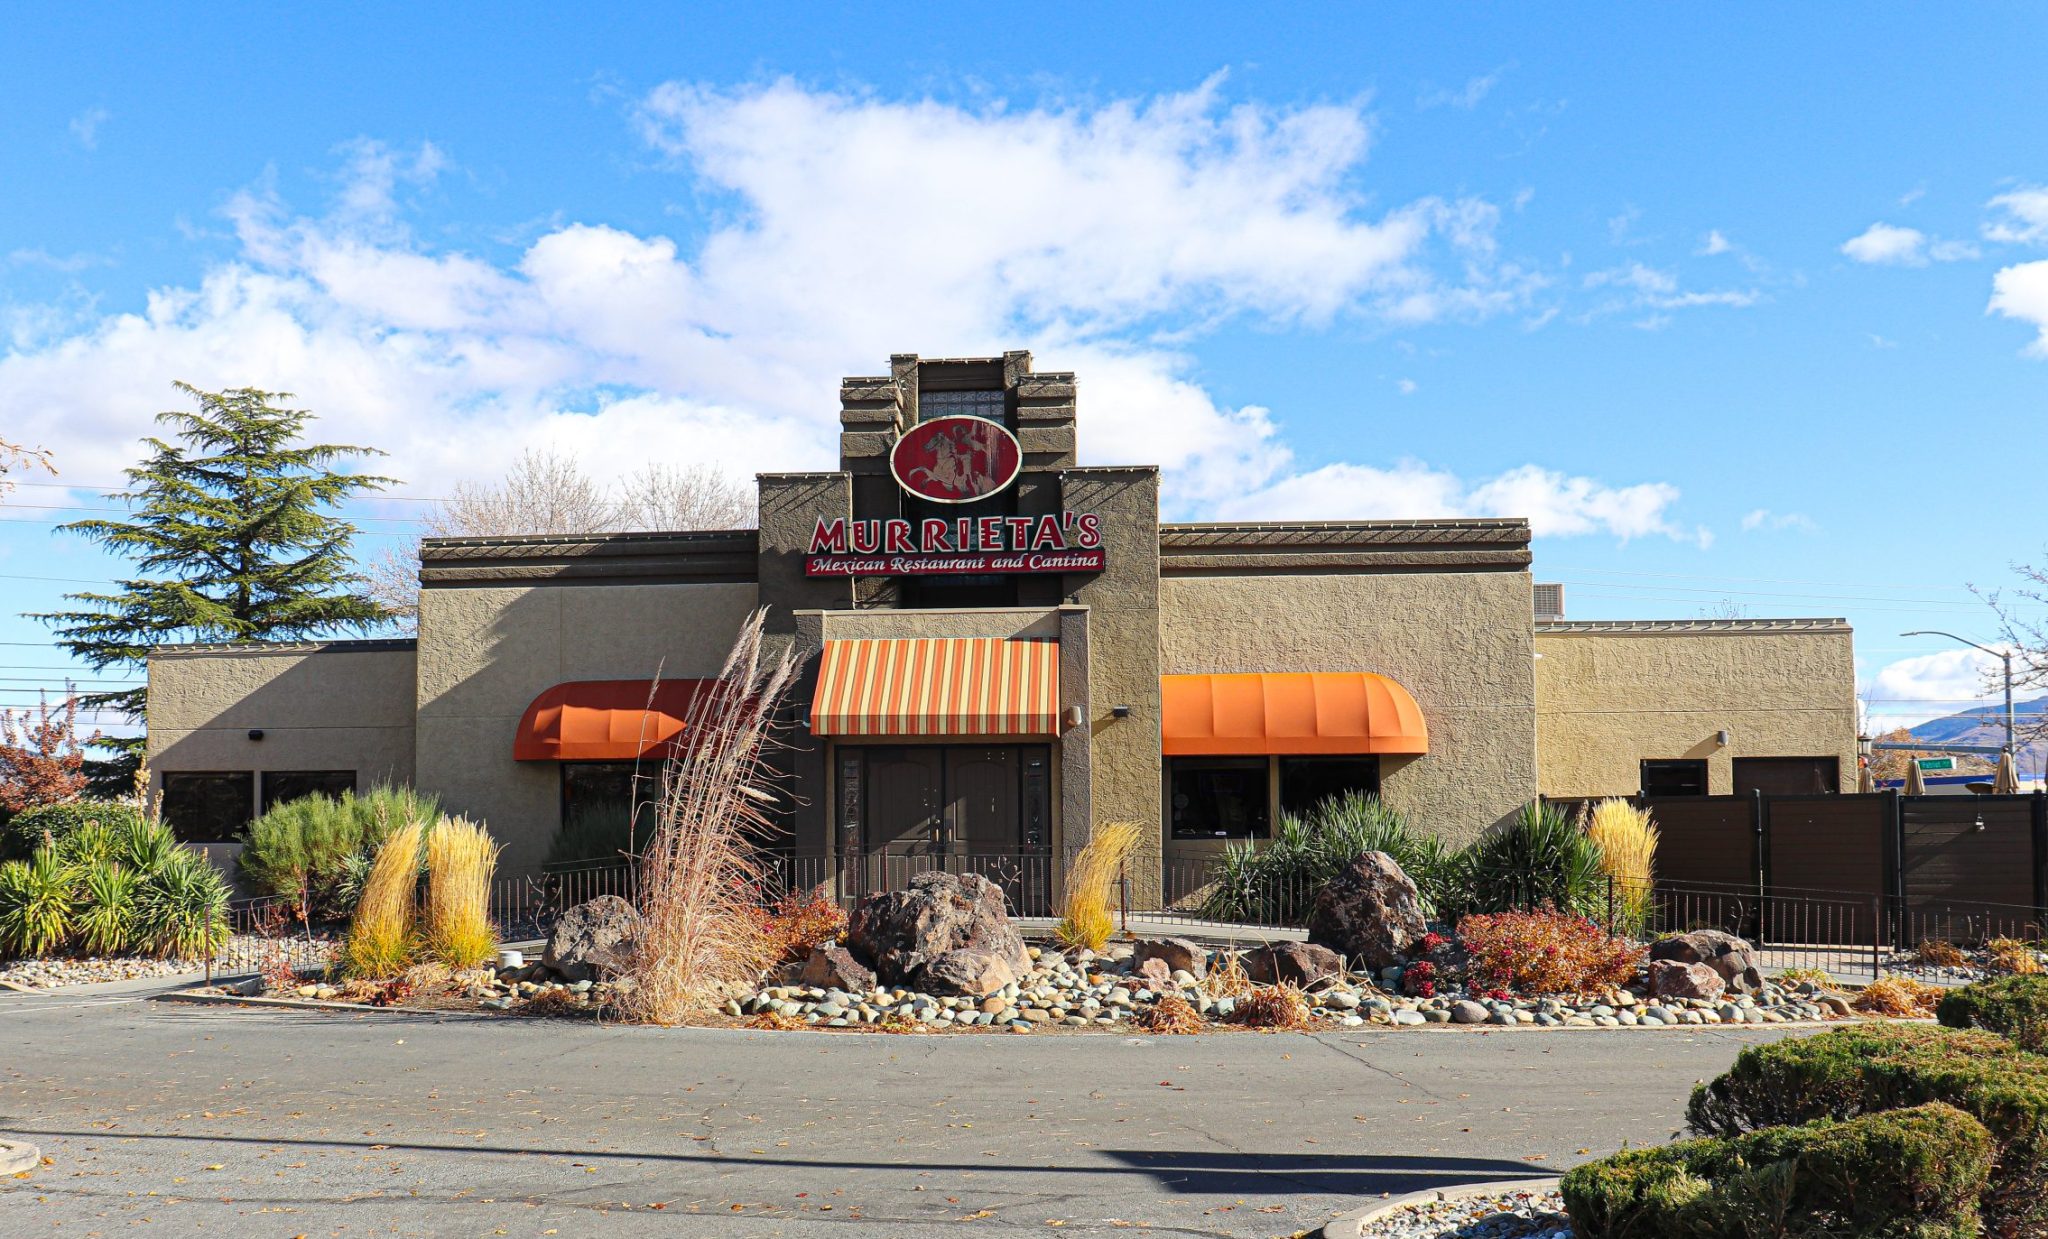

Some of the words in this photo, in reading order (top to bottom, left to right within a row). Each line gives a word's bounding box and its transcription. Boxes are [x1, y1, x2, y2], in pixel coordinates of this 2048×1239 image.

[808, 511, 1101, 554] MURRIETA'S
[812, 557, 886, 574] Mexican
[890, 557, 985, 573] Restaurant
[991, 553, 1028, 569] and
[1029, 553, 1099, 569] Cantina
